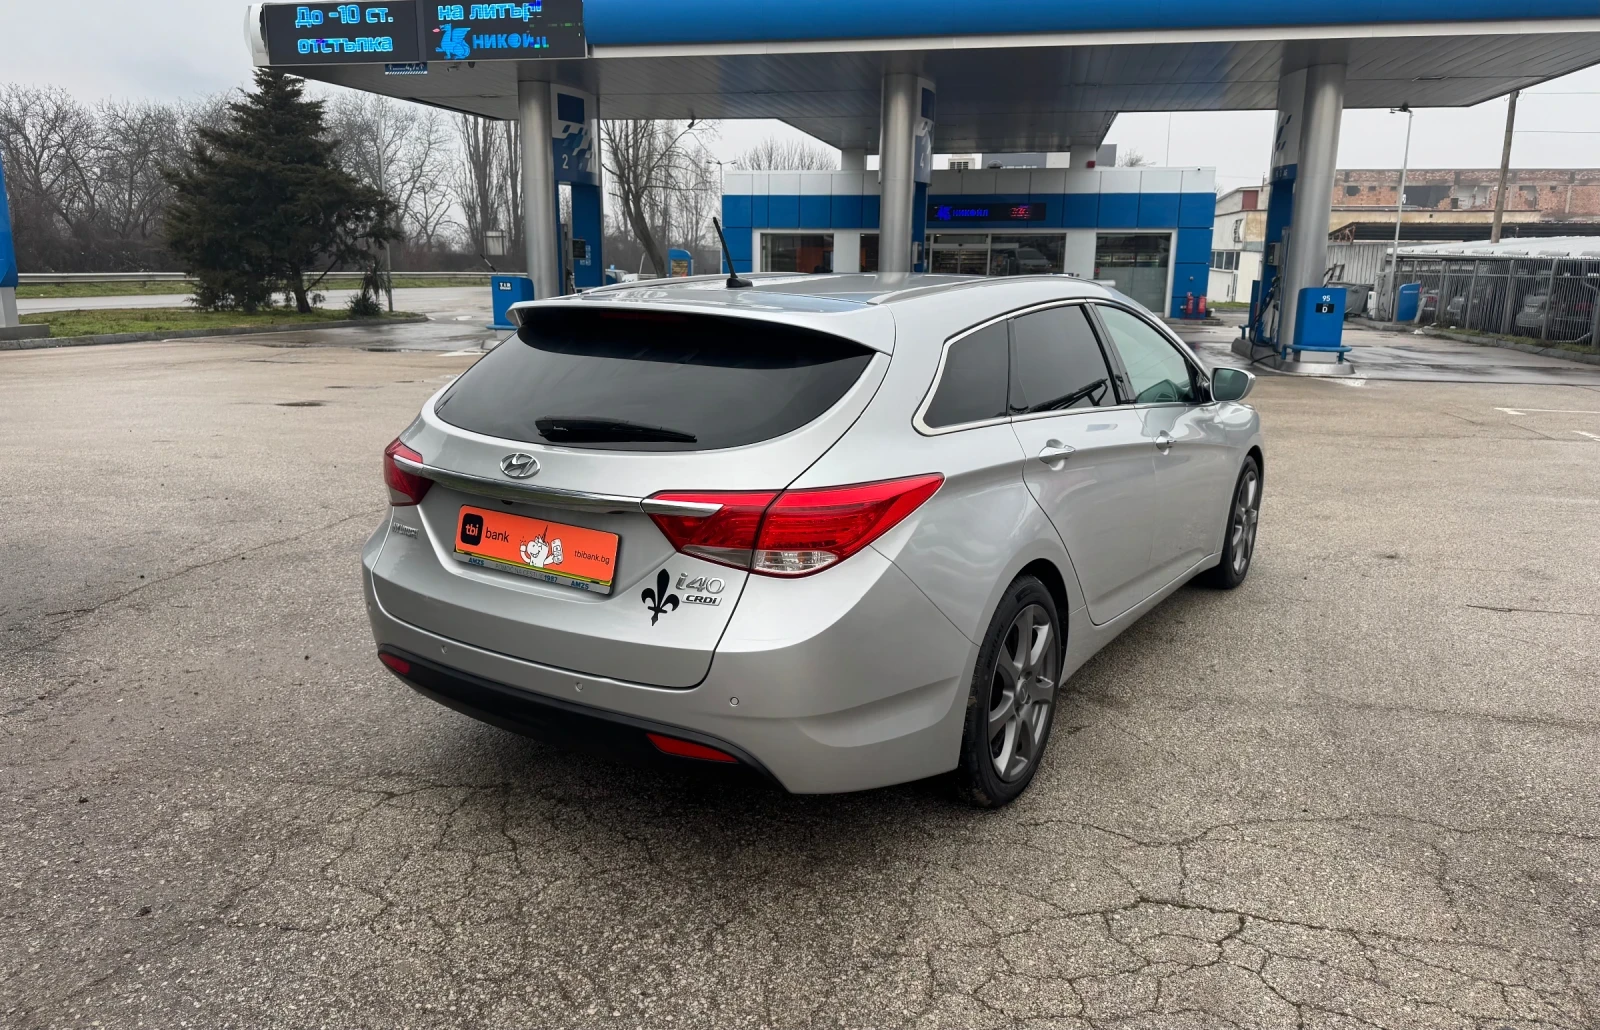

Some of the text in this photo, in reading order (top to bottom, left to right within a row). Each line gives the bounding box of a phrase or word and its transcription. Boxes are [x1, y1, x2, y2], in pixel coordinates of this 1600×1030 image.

[295, 4, 394, 28] До -10 ст.
[437, 4, 465, 21] на
[297, 37, 393, 54] отстъпка
[562, 154, 569, 169] 2
[465, 524, 510, 543] tbi bank
[574, 550, 610, 566] tbibank.bg
[468, 557, 485, 567] AMZS
[544, 574, 558, 583] 1987
[570, 580, 590, 590] AMZS
[675, 572, 726, 594] i40
